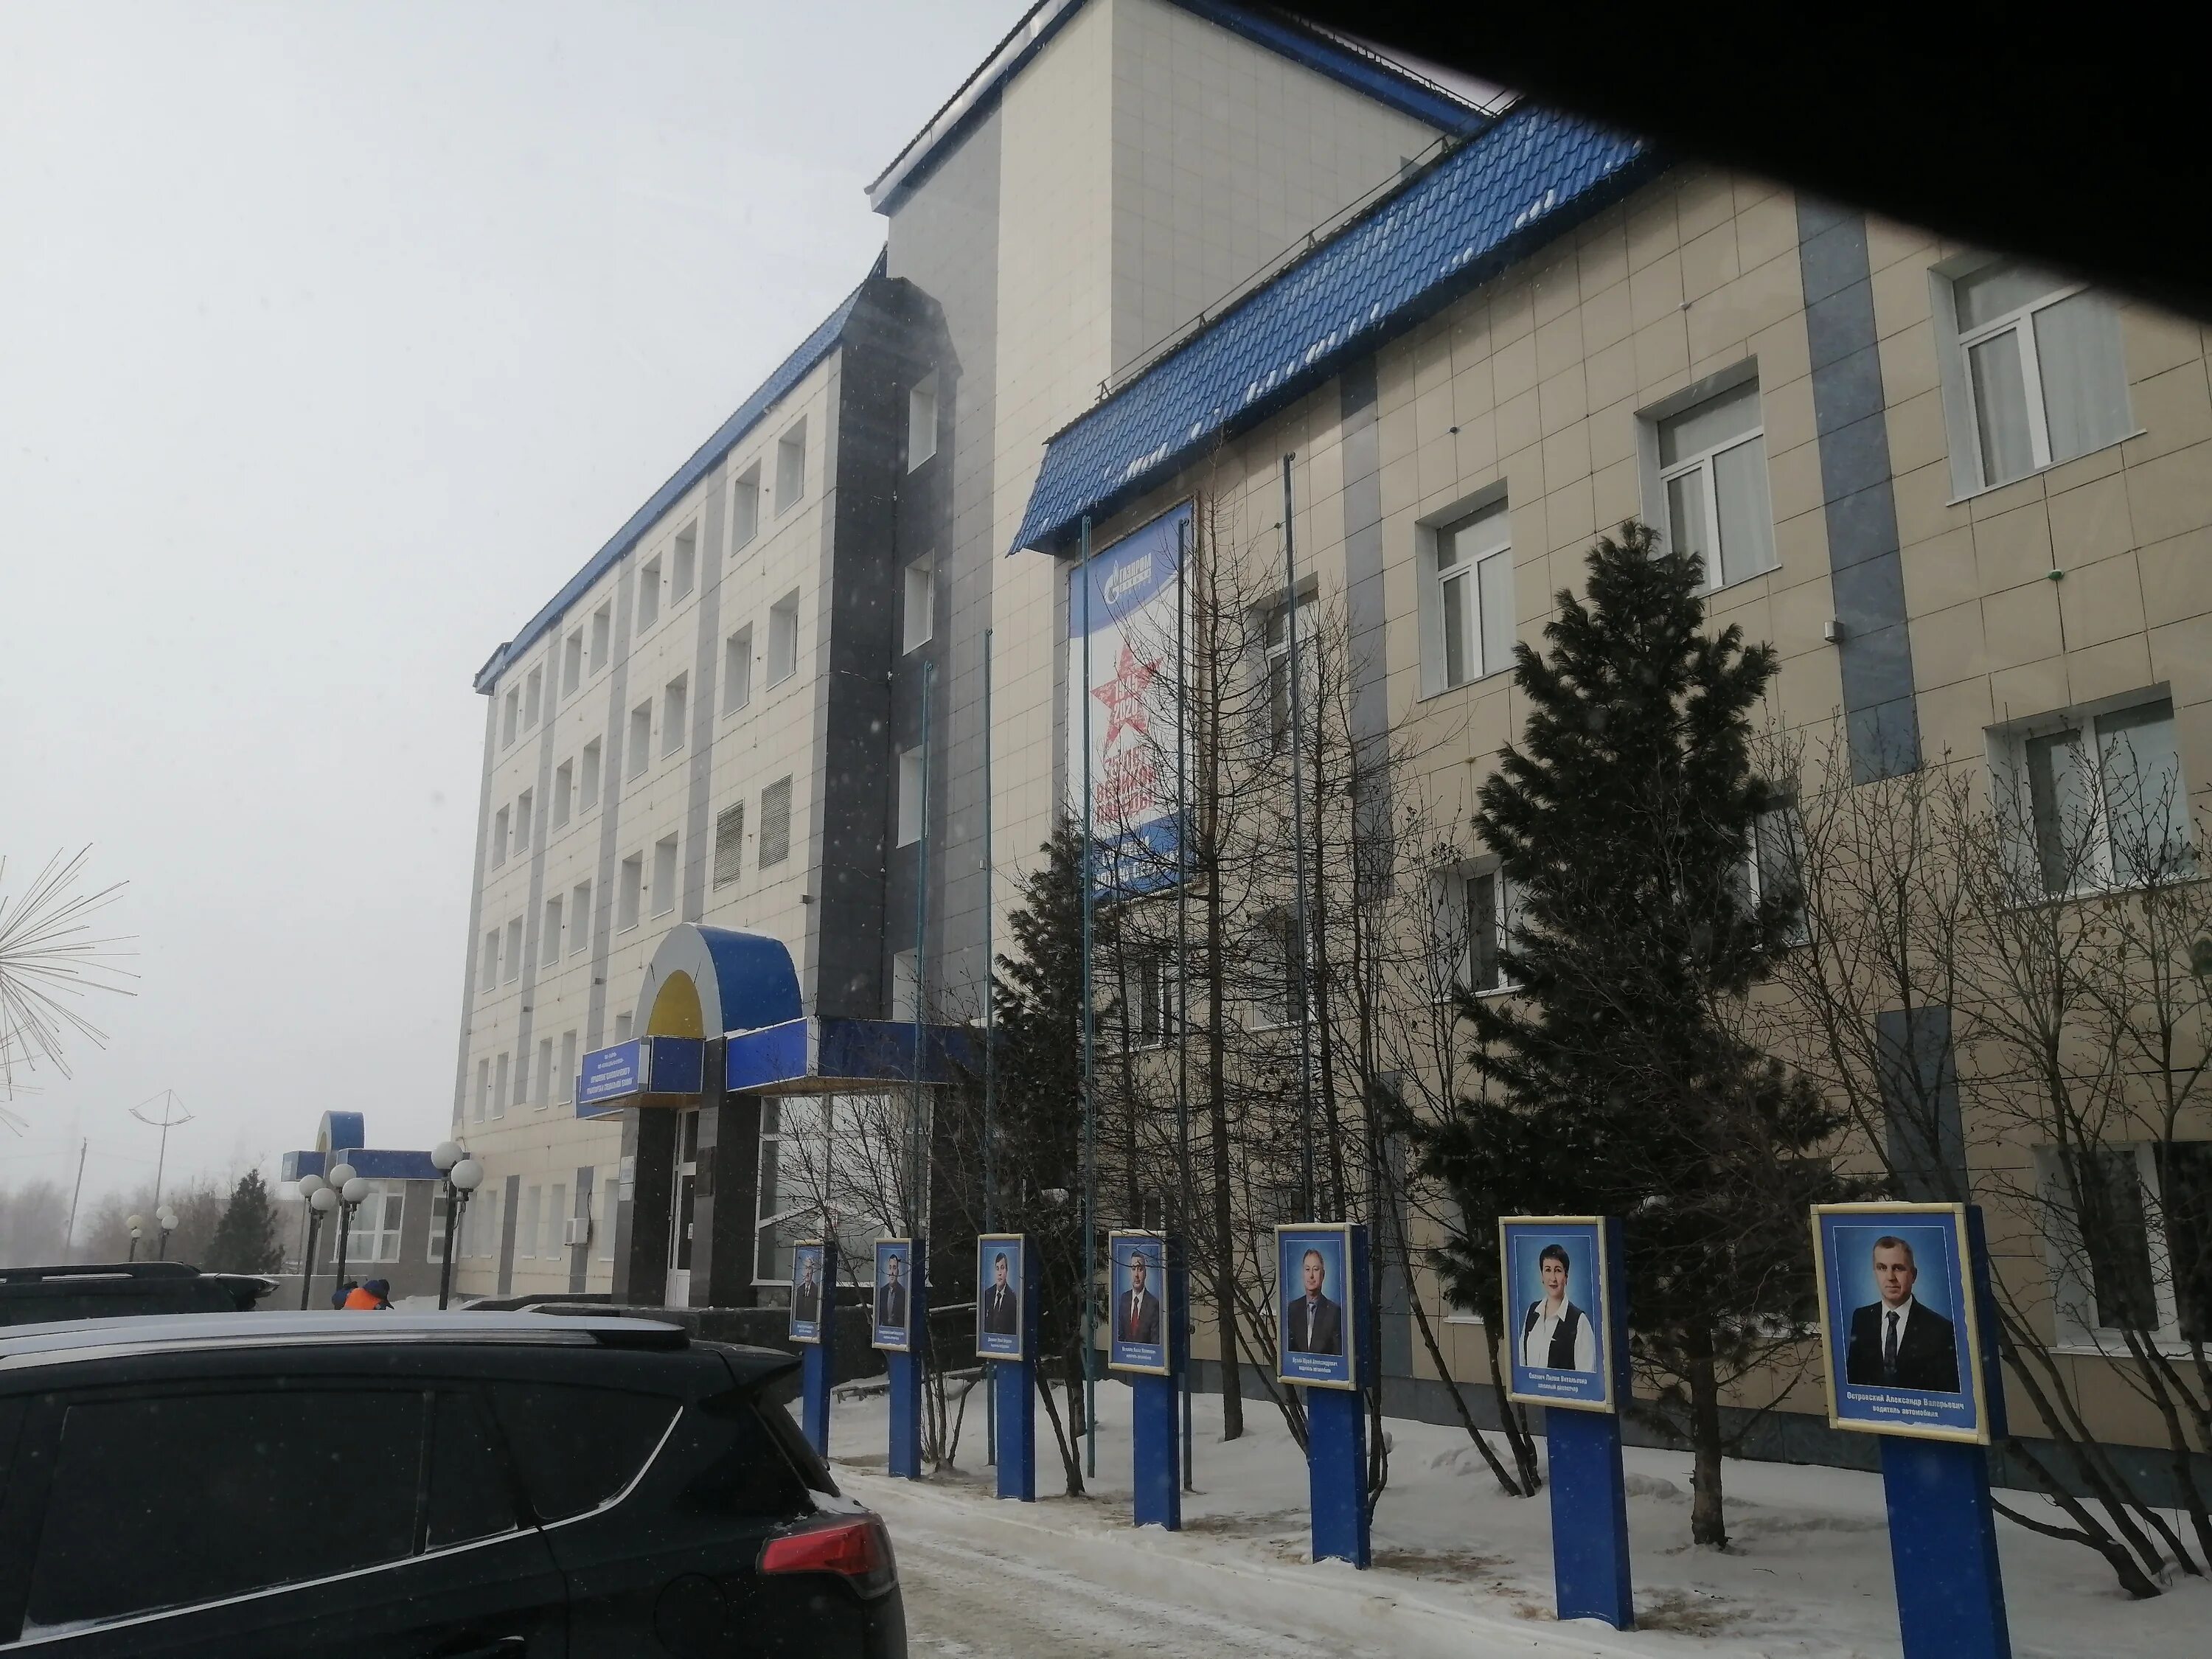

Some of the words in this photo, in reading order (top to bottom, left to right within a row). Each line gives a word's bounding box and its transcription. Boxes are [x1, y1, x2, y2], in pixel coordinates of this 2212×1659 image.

[1119, 552, 1152, 583] ГАЗПРОМ
[1115, 674, 1138, 701] 1945
[1113, 695, 1138, 723] 2020
[1846, 1391, 1885, 1402] Островский
[1885, 1394, 1922, 1406] Александр
[1923, 1398, 1964, 1410] Валерьевич
[1872, 1405, 1901, 1413] водитель
[1902, 1408, 1939, 1418] автомобиля
